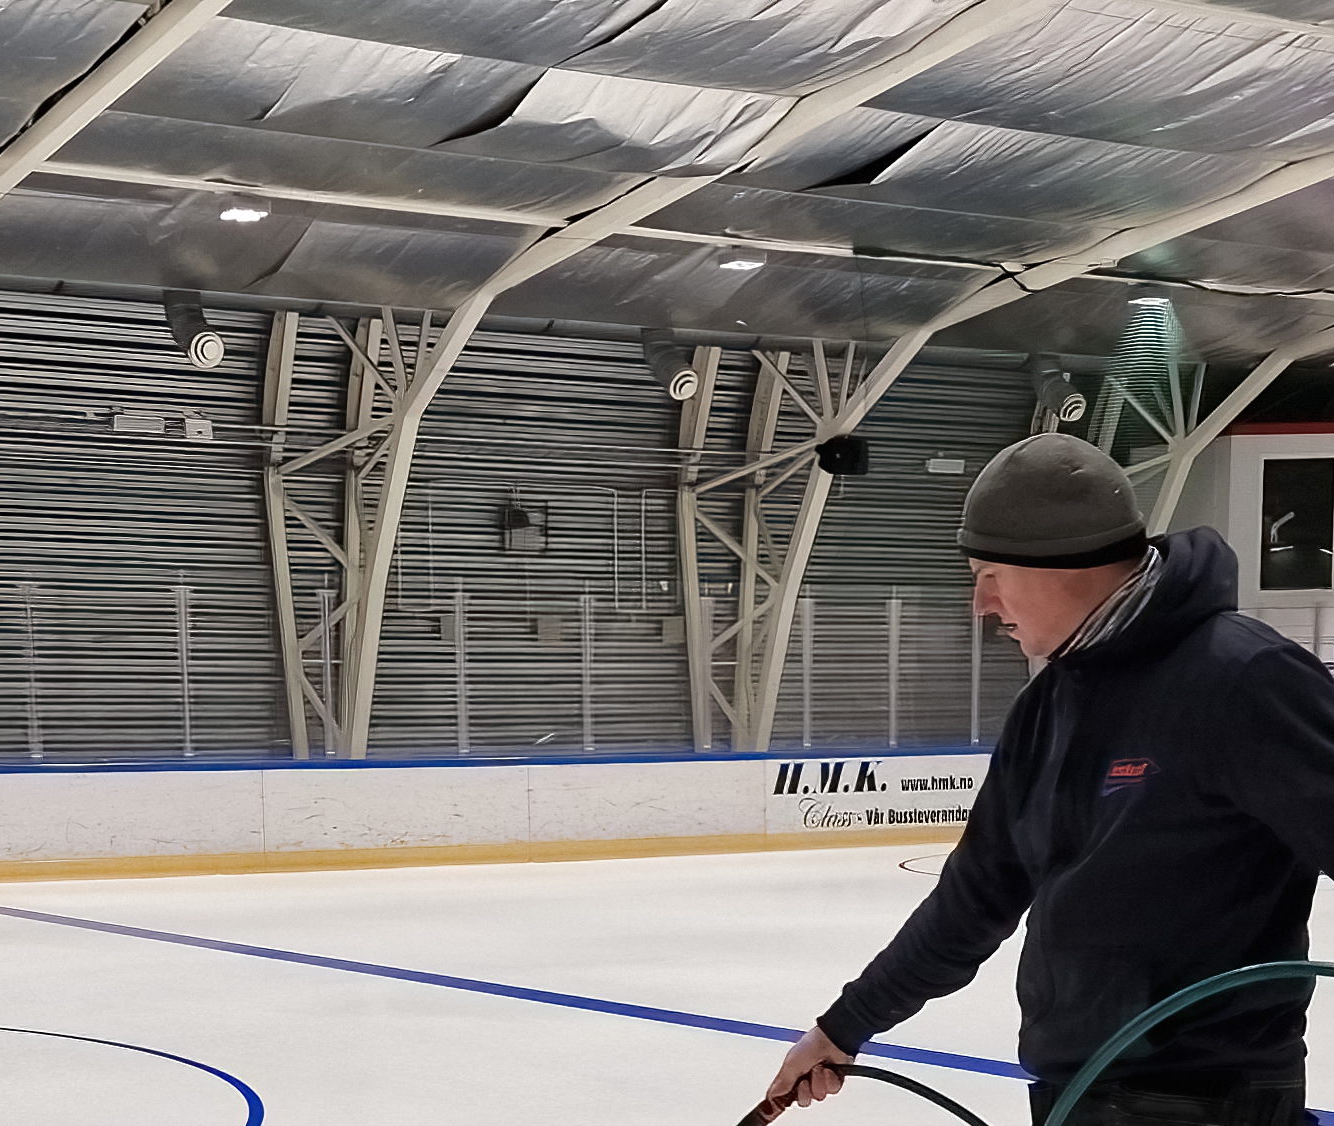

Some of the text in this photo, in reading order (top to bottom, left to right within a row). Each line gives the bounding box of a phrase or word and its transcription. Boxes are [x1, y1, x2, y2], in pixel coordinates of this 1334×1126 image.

[773, 760, 974, 795] H.M.K. www.hmk.no
[866, 807, 884, 825] Vår
